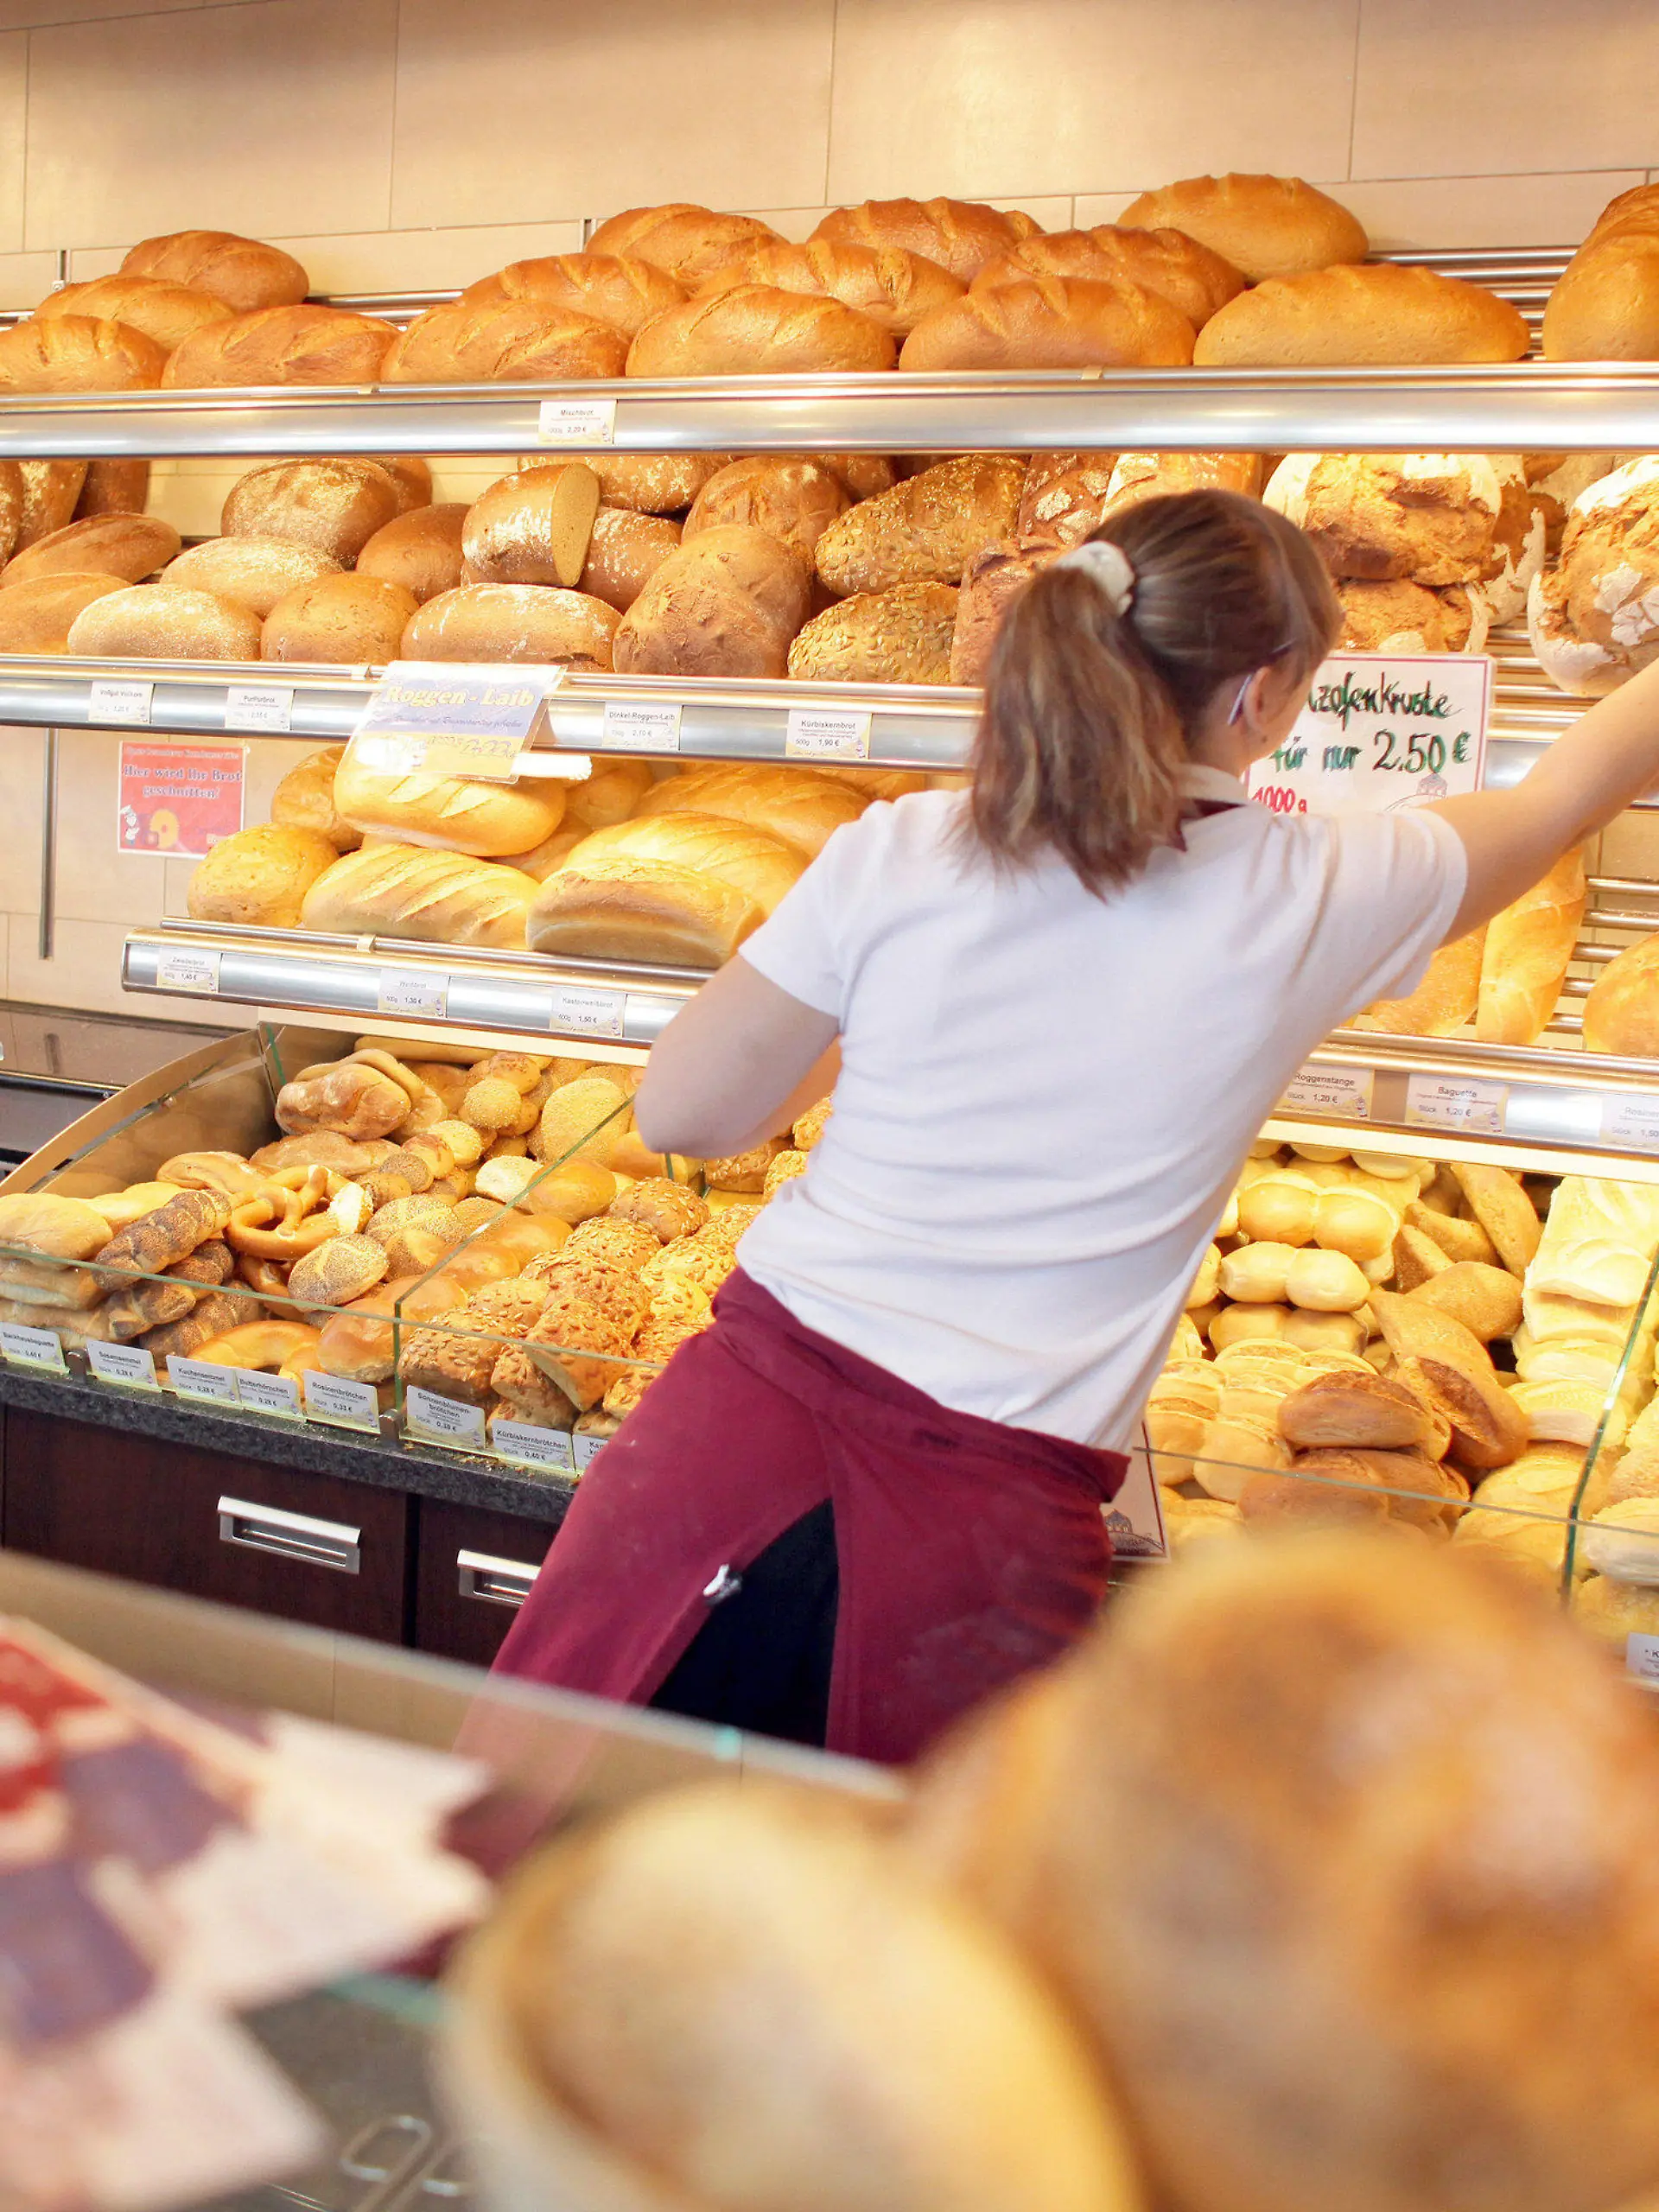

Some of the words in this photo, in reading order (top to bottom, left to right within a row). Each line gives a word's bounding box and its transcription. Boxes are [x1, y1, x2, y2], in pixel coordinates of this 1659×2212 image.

[383, 685, 467, 707] Roggen
[479, 689, 536, 708] Laib
[1322, 744, 1363, 772] nur
[1371, 728, 1447, 774] 2.50
[1452, 730, 1472, 765] €
[124, 764, 150, 779] Hier
[154, 766, 184, 781] wird
[1294, 1072, 1356, 1087] Roggenstange
[1437, 1085, 1478, 1098] Baguette
